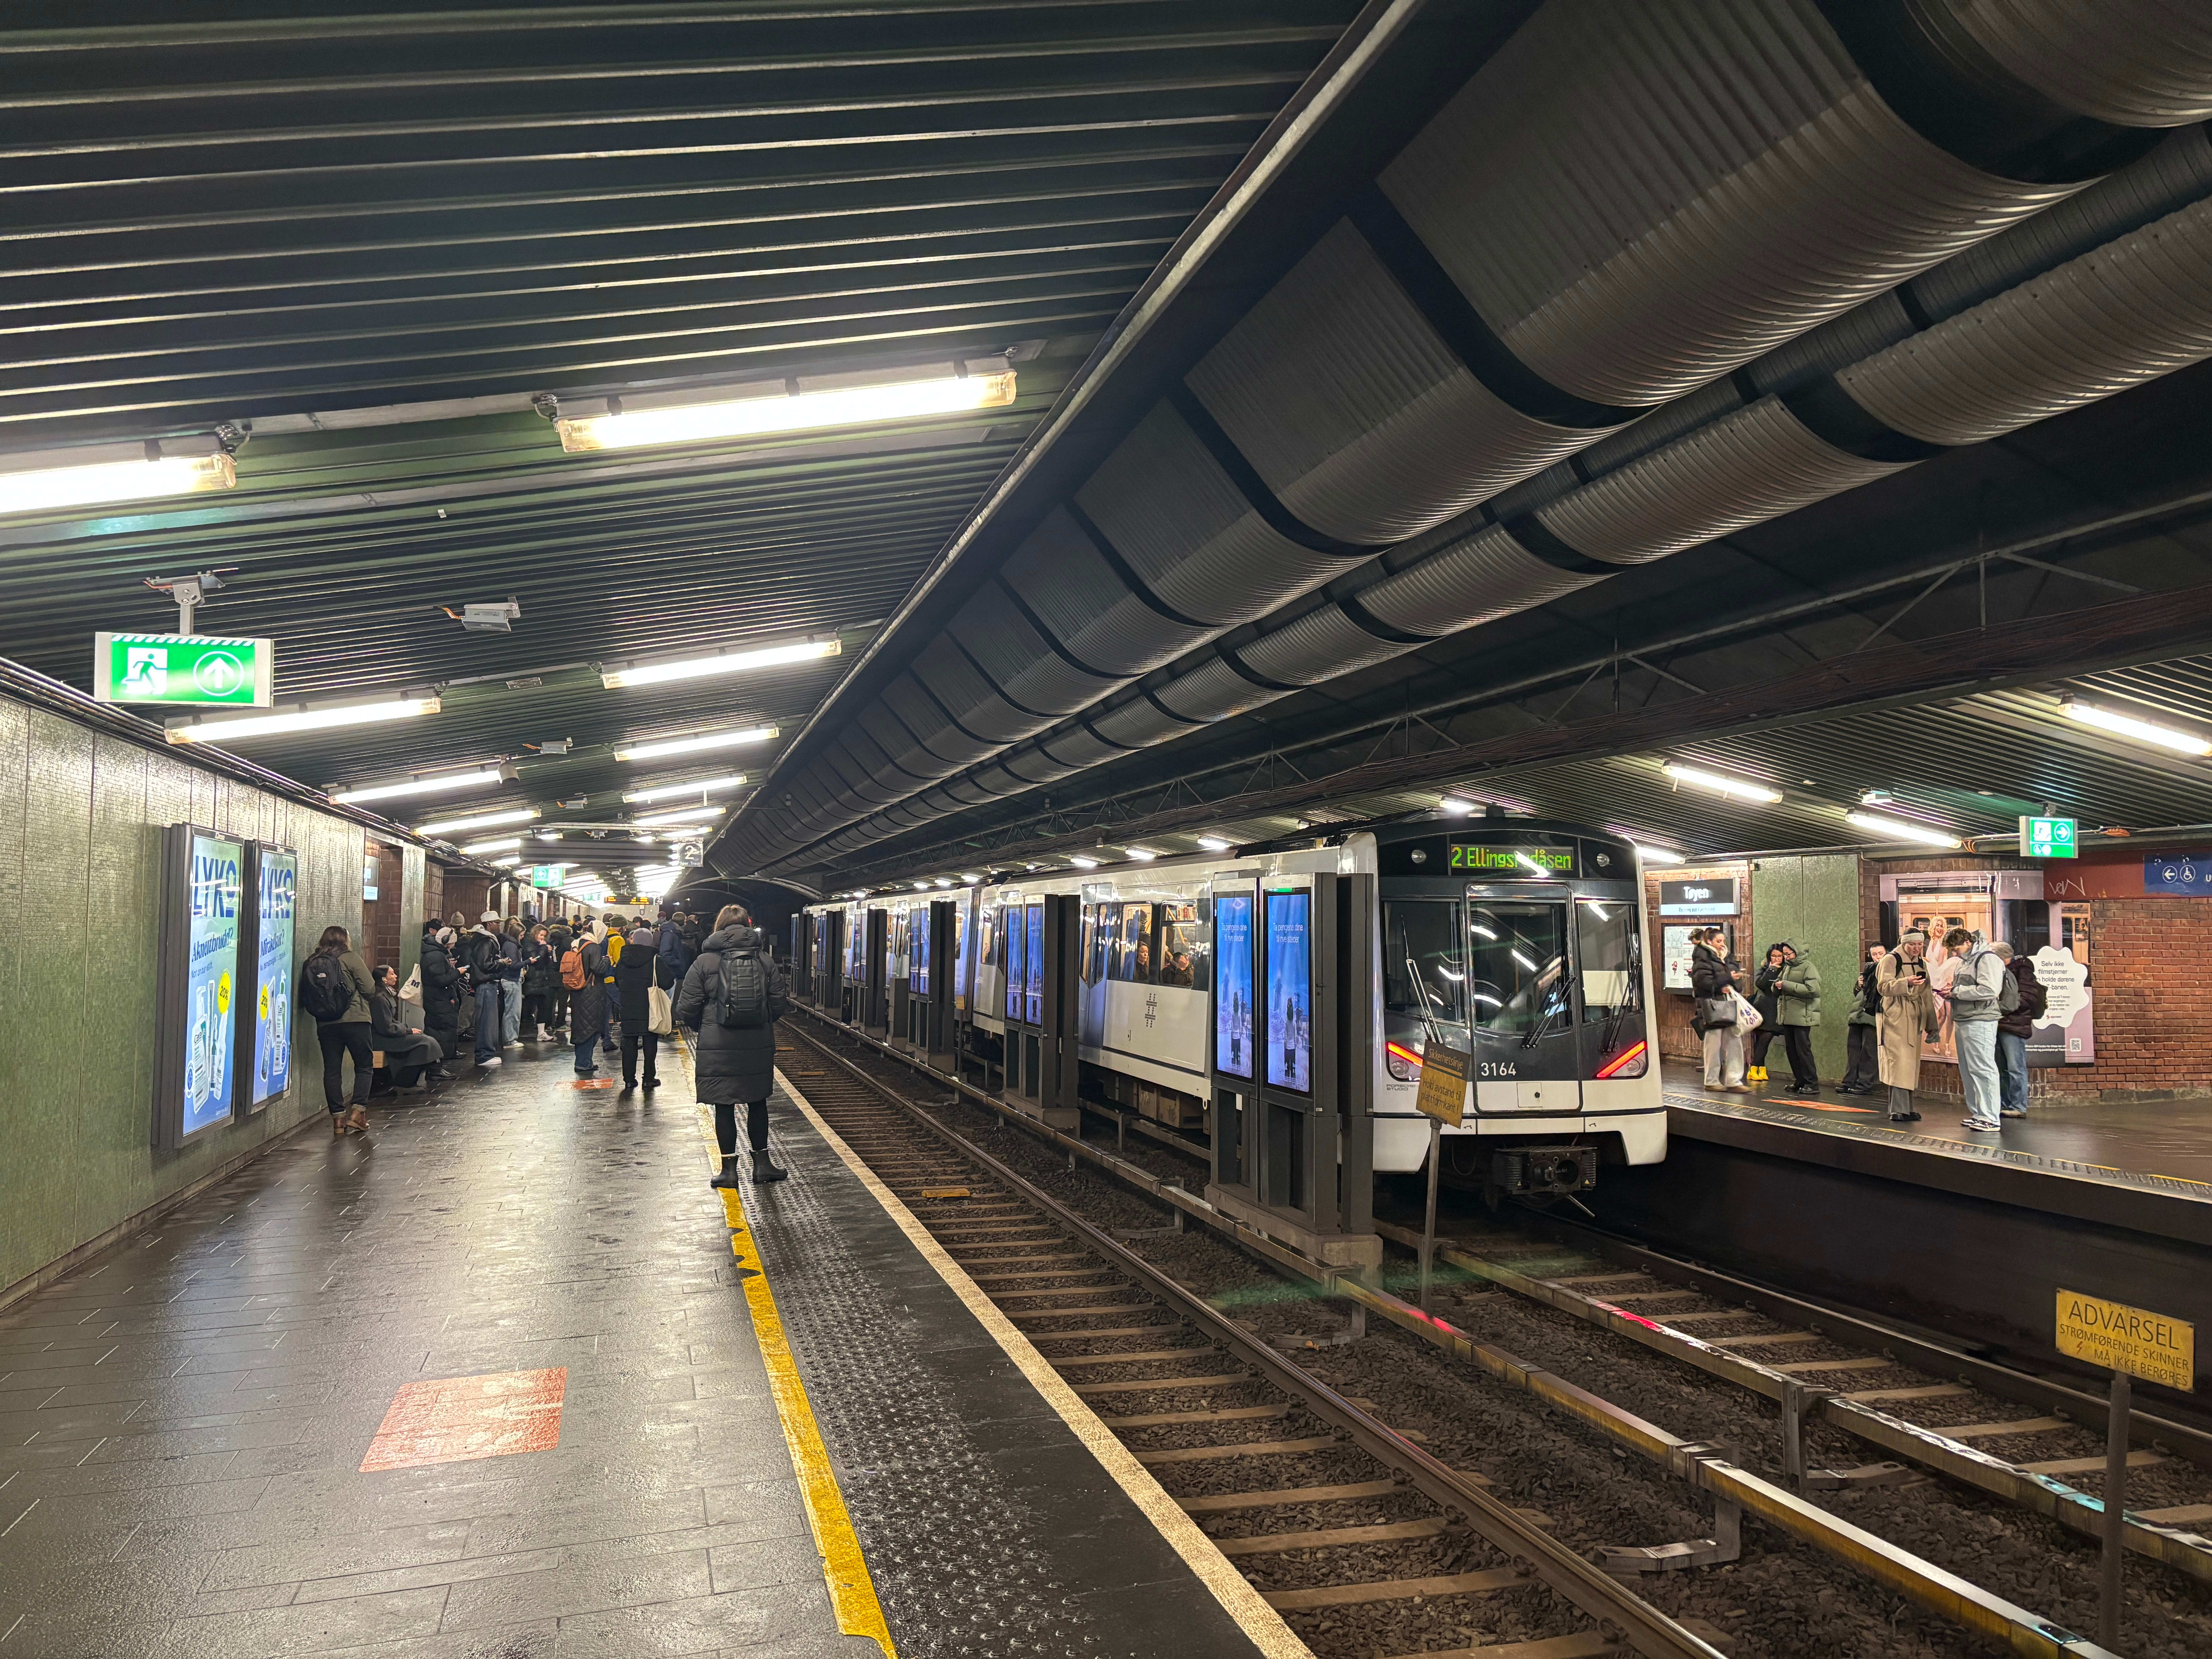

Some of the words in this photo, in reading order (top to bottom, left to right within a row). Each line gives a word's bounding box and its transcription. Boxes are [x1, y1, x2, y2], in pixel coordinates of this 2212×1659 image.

[685, 845, 694, 860] 2
[1452, 847, 1462, 866] 2
[1467, 847, 1571, 869] Ellingsrdåsen
[2205, 874, 2212, 882] U
[1273, 922, 1278, 931] Ta
[1278, 924, 1294, 933] pengene
[1295, 922, 1303, 931] dine
[220, 986, 228, 1000] 20%
[1429, 1048, 1463, 1070] Sikkerhetslinje
[1481, 1062, 1516, 1076] 3164
[1423, 1078, 1433, 1088] Hold
[1434, 1084, 1454, 1098] avstand
[2069, 1300, 2179, 1350] ADVARSEL
[2059, 1324, 2139, 1356] STRØMFØRENDE
[2143, 1348, 2189, 1371] SKINNER
[2094, 1348, 2111, 1362] MÅ
[2114, 1355, 2137, 1371] IKKE
[2140, 1362, 2188, 1386] BERØRES
